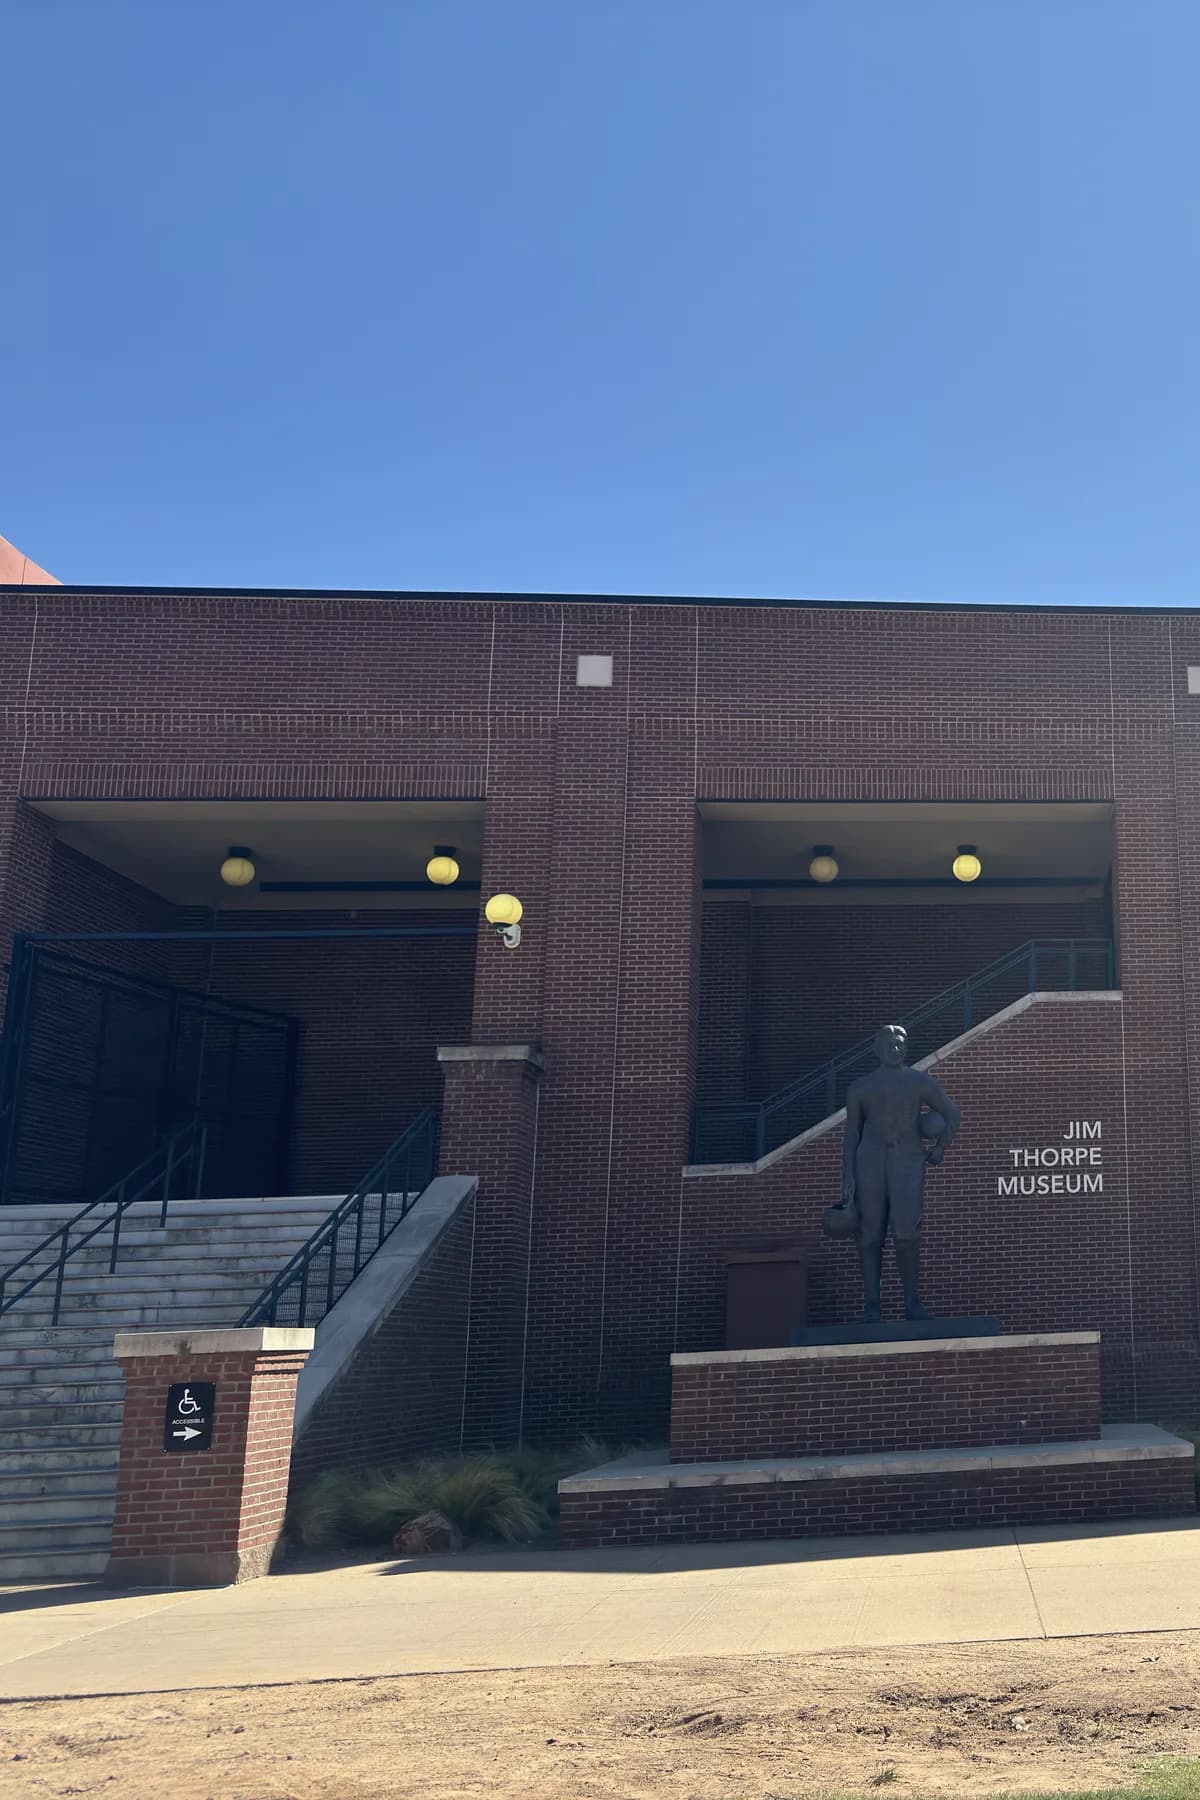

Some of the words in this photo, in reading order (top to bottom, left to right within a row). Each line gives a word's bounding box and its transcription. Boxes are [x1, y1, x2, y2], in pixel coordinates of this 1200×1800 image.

[1063, 1120, 1102, 1140] JIM
[1009, 1147, 1102, 1167] THORPE
[997, 1173, 1104, 1196] MUSEUM
